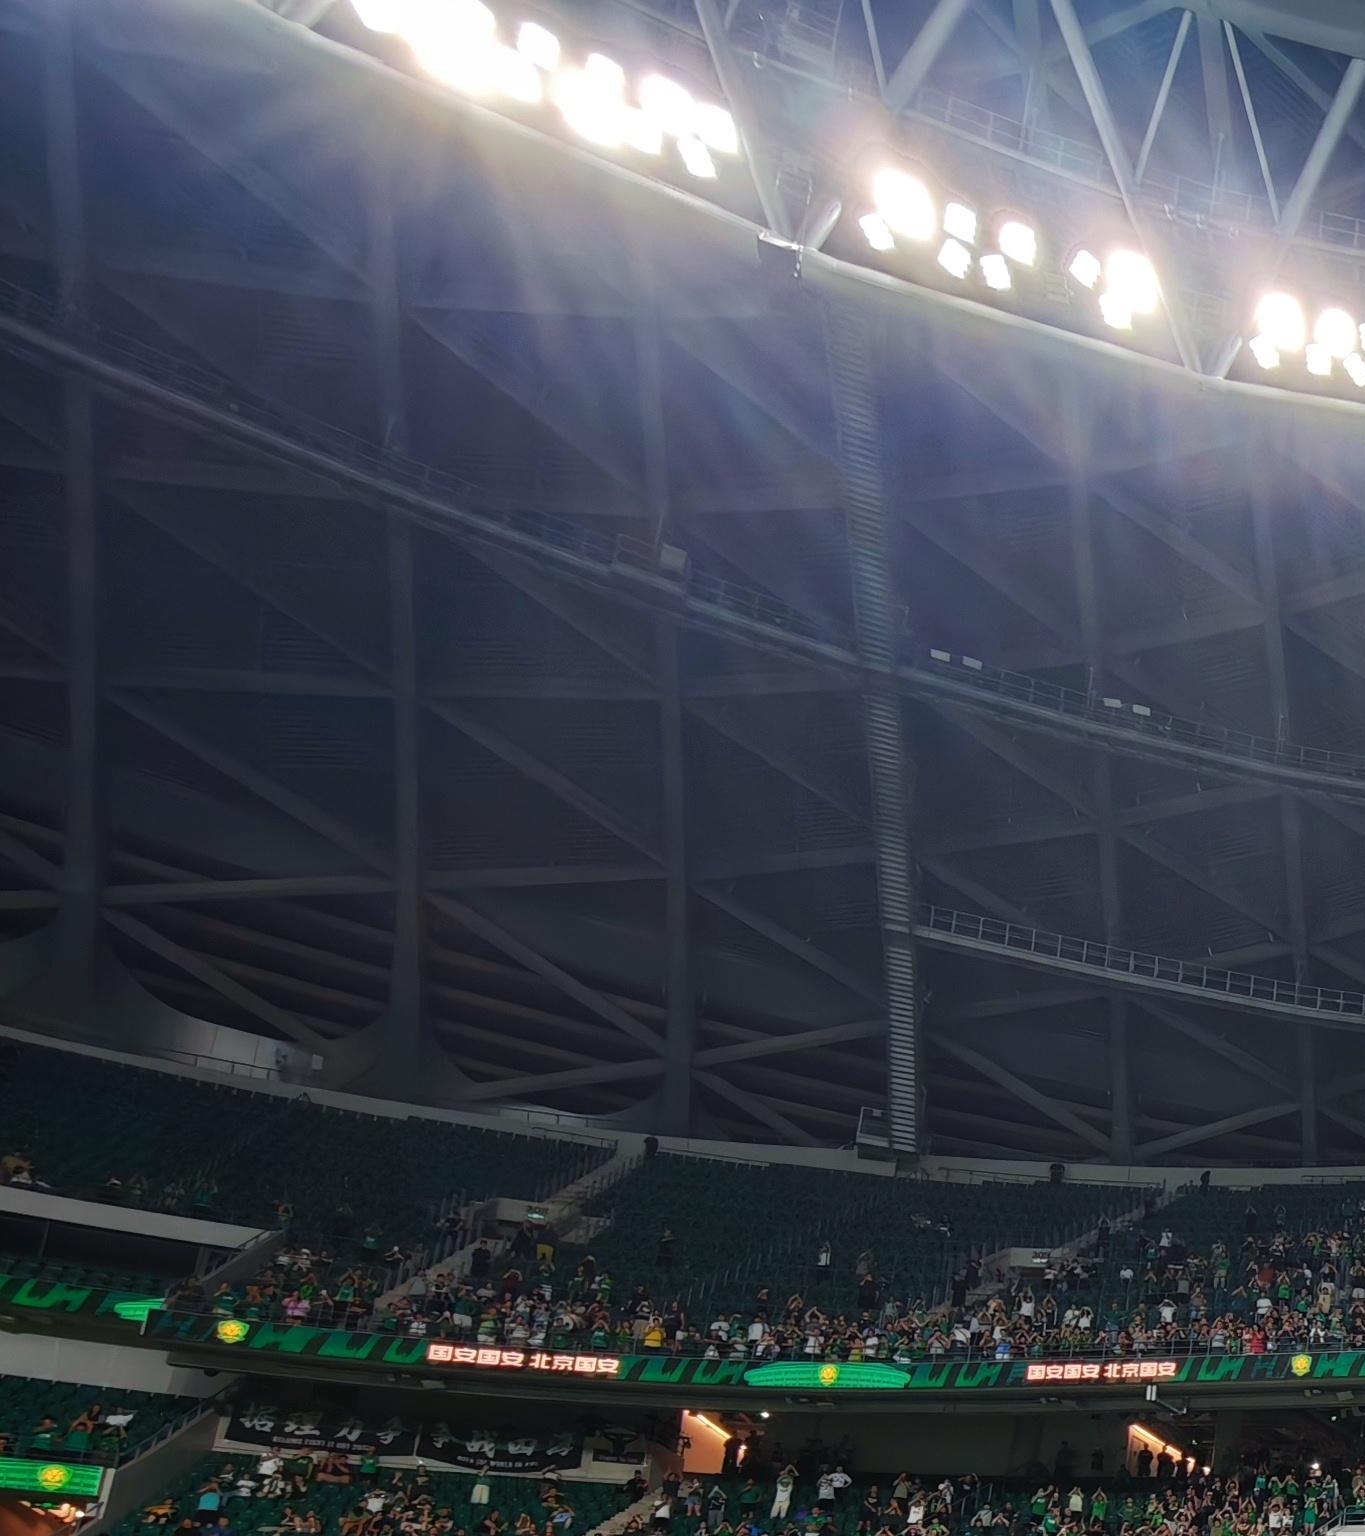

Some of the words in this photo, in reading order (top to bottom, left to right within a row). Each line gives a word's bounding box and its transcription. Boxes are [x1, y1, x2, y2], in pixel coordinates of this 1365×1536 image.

[428, 1344, 525, 1368] 国安国安
[528, 1352, 621, 1374] 北京国安
[1027, 1363, 1100, 1380] 国安国安
[1103, 1361, 1177, 1378] 北京国安
